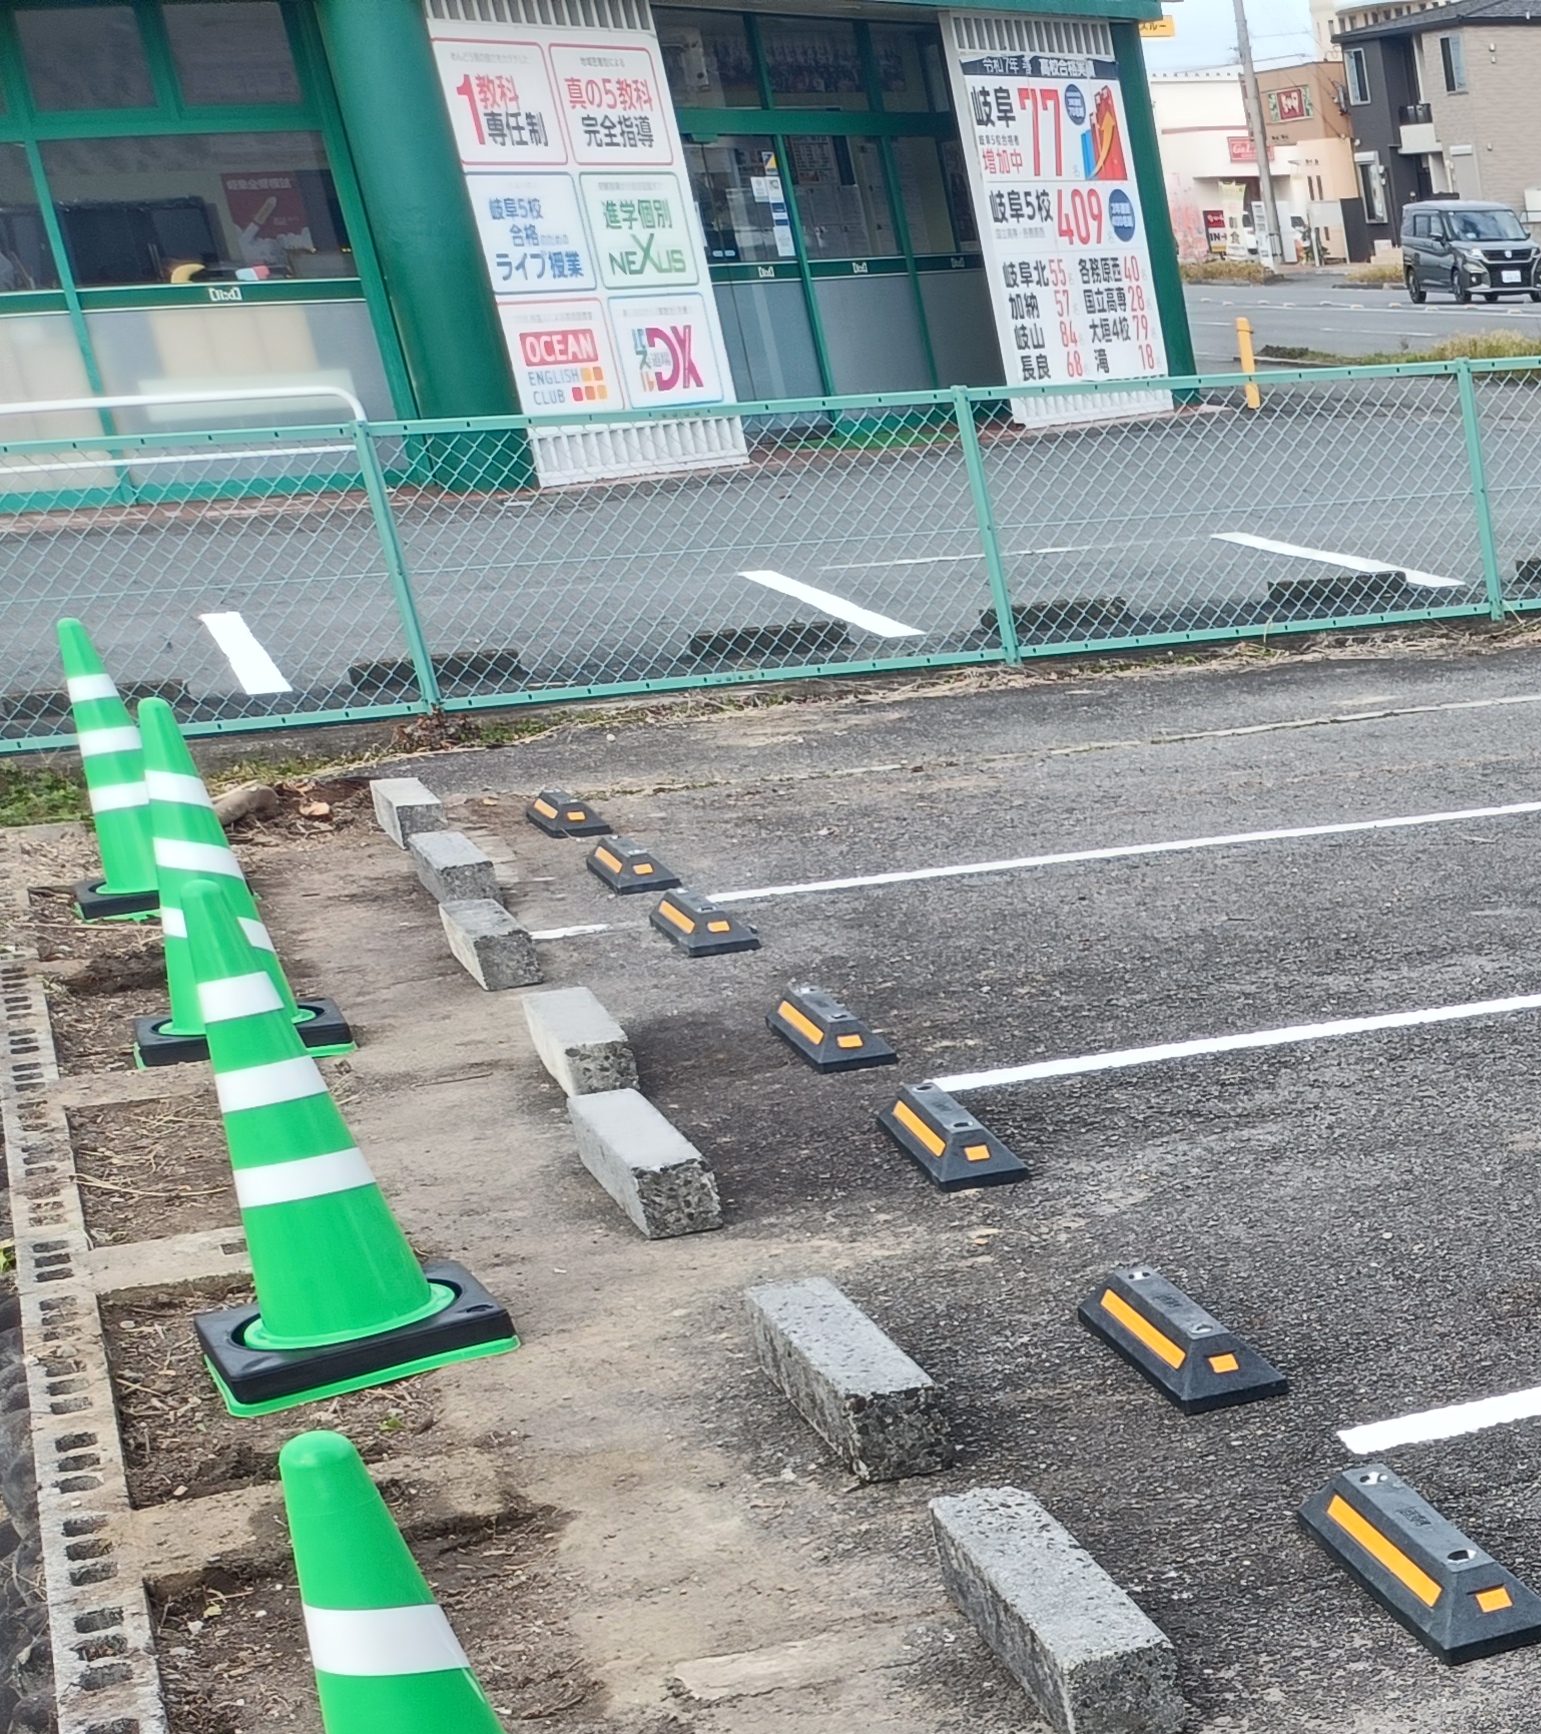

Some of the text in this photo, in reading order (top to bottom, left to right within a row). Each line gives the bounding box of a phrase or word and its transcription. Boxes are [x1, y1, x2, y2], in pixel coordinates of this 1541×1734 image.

[564, 77, 653, 112] 真の5教科
[483, 111, 549, 147] 専任制
[582, 114, 655, 148] 完全指導
[971, 85, 1016, 128] 岐阜
[1017, 87, 1063, 177] 77
[982, 147, 1024, 175] 増加中
[489, 197, 544, 221] 岐阜5校
[601, 197, 673, 230] 進学個別
[988, 188, 1054, 225] 岐阜5校
[1056, 187, 1103, 246] 409
[509, 223, 540, 248] 合格
[495, 250, 584, 281] ライブ授業
[609, 233, 687, 276] NEXUS
[1078, 257, 1122, 285] 各務原西
[1124, 255, 1140, 283] 40
[1002, 260, 1049, 288] 岐阜北
[1049, 258, 1067, 287] 55
[1008, 292, 1040, 320] 加納
[1053, 289, 1070, 318] 57
[1083, 286, 1127, 315] 国立高専
[1128, 285, 1145, 312] 28
[1014, 323, 1046, 351] 岐山
[1059, 320, 1078, 348] 84
[1089, 316, 1131, 344] 大垣4校
[1132, 315, 1148, 341] 79
[525, 332, 597, 364] OCEAN
[1093, 348, 1110, 374] 滝
[1138, 343, 1155, 370] 18
[528, 368, 580, 387] ENGLISH
[1020, 353, 1051, 382] 長良
[1067, 350, 1083, 378] 68
[533, 389, 566, 406] CLUB
